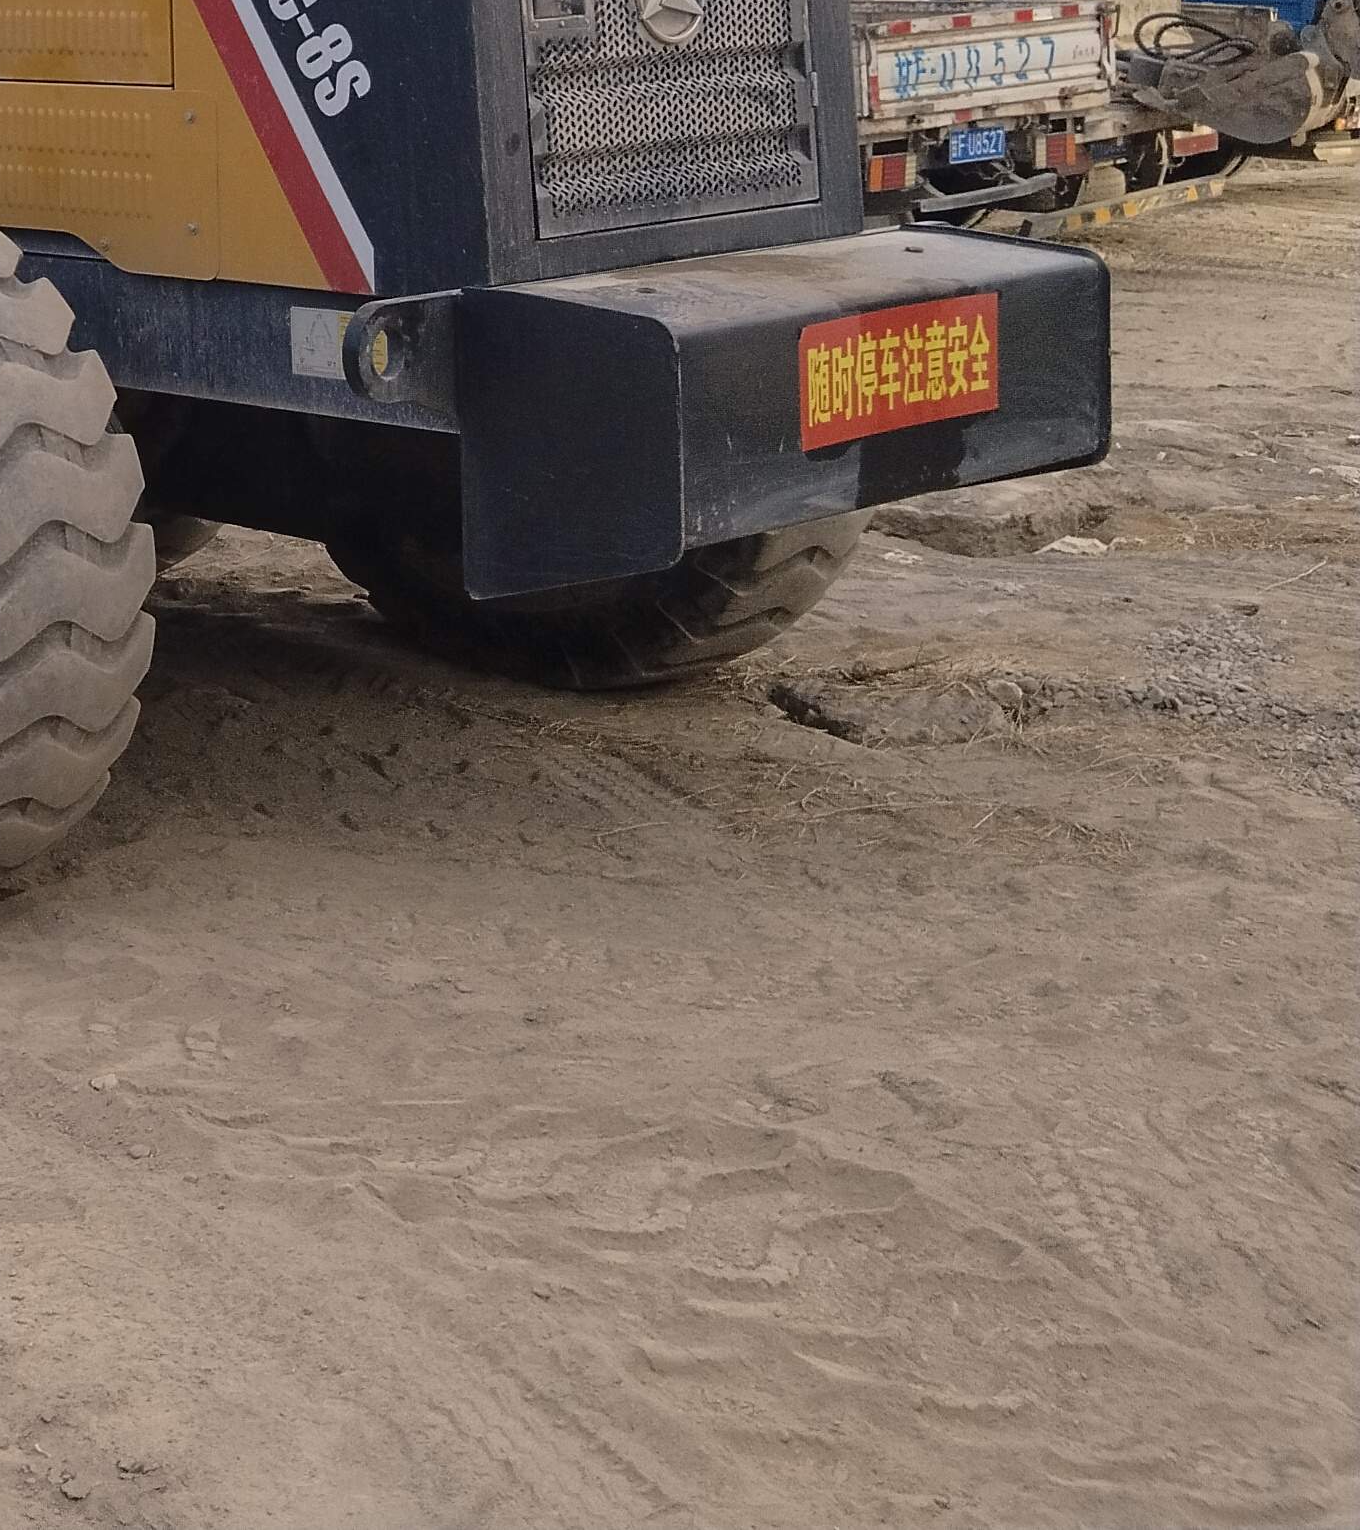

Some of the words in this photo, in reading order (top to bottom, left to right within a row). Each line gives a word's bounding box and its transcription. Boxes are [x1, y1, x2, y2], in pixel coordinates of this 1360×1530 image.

[807, 313, 991, 428] 随时停车注意安全
